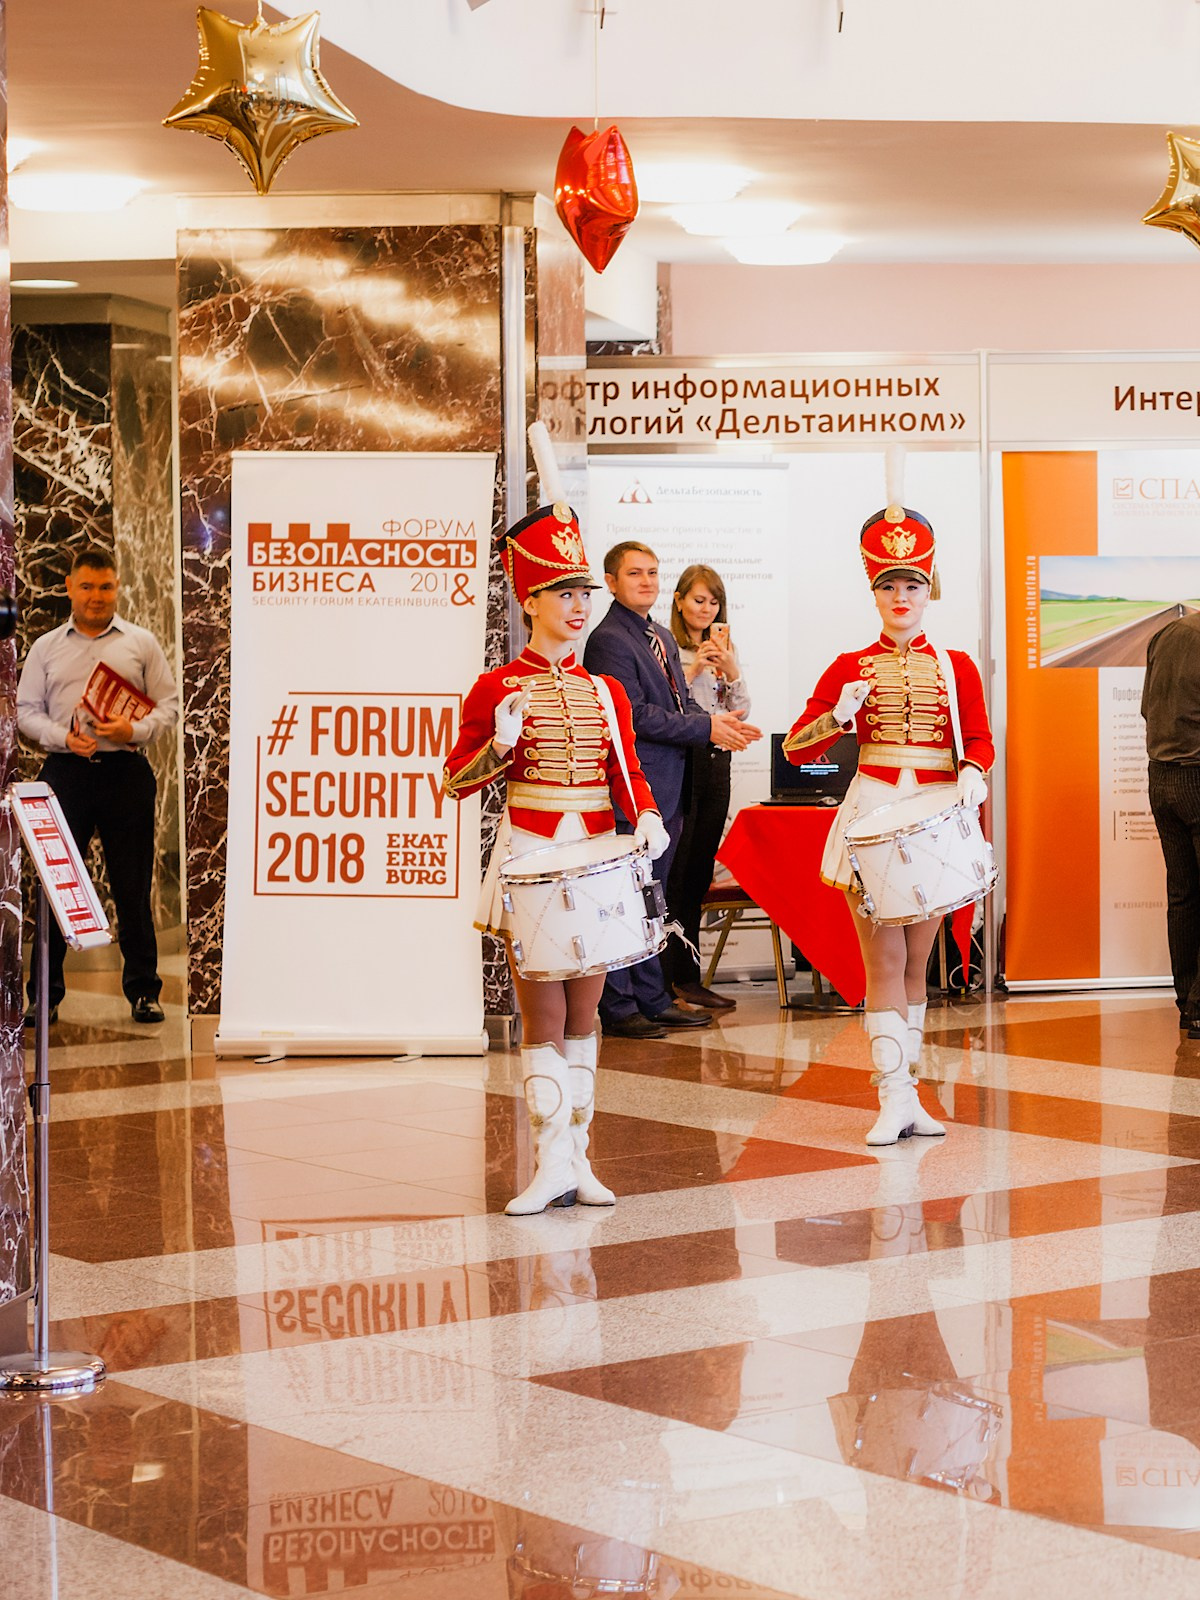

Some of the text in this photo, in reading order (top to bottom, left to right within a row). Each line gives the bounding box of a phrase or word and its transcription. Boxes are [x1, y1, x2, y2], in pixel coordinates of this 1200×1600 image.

[632, 373, 940, 406] информационных
[696, 408, 966, 440] «Дельтаинком»
[382, 519, 476, 538] ФОРУМ
[252, 541, 476, 567] БЕЗОПАСНОСТЬ
[252, 572, 377, 593] БИЗНЕСА
[252, 595, 448, 608] SECURITY FORUM EKATERINBURG
[267, 705, 454, 757] # FORUM
[265, 771, 446, 819] SECURITY
[386, 833, 449, 849] EKAT
[267, 832, 366, 884] 2018
[386, 851, 448, 867] ERIN
[386, 869, 448, 885] BURG
